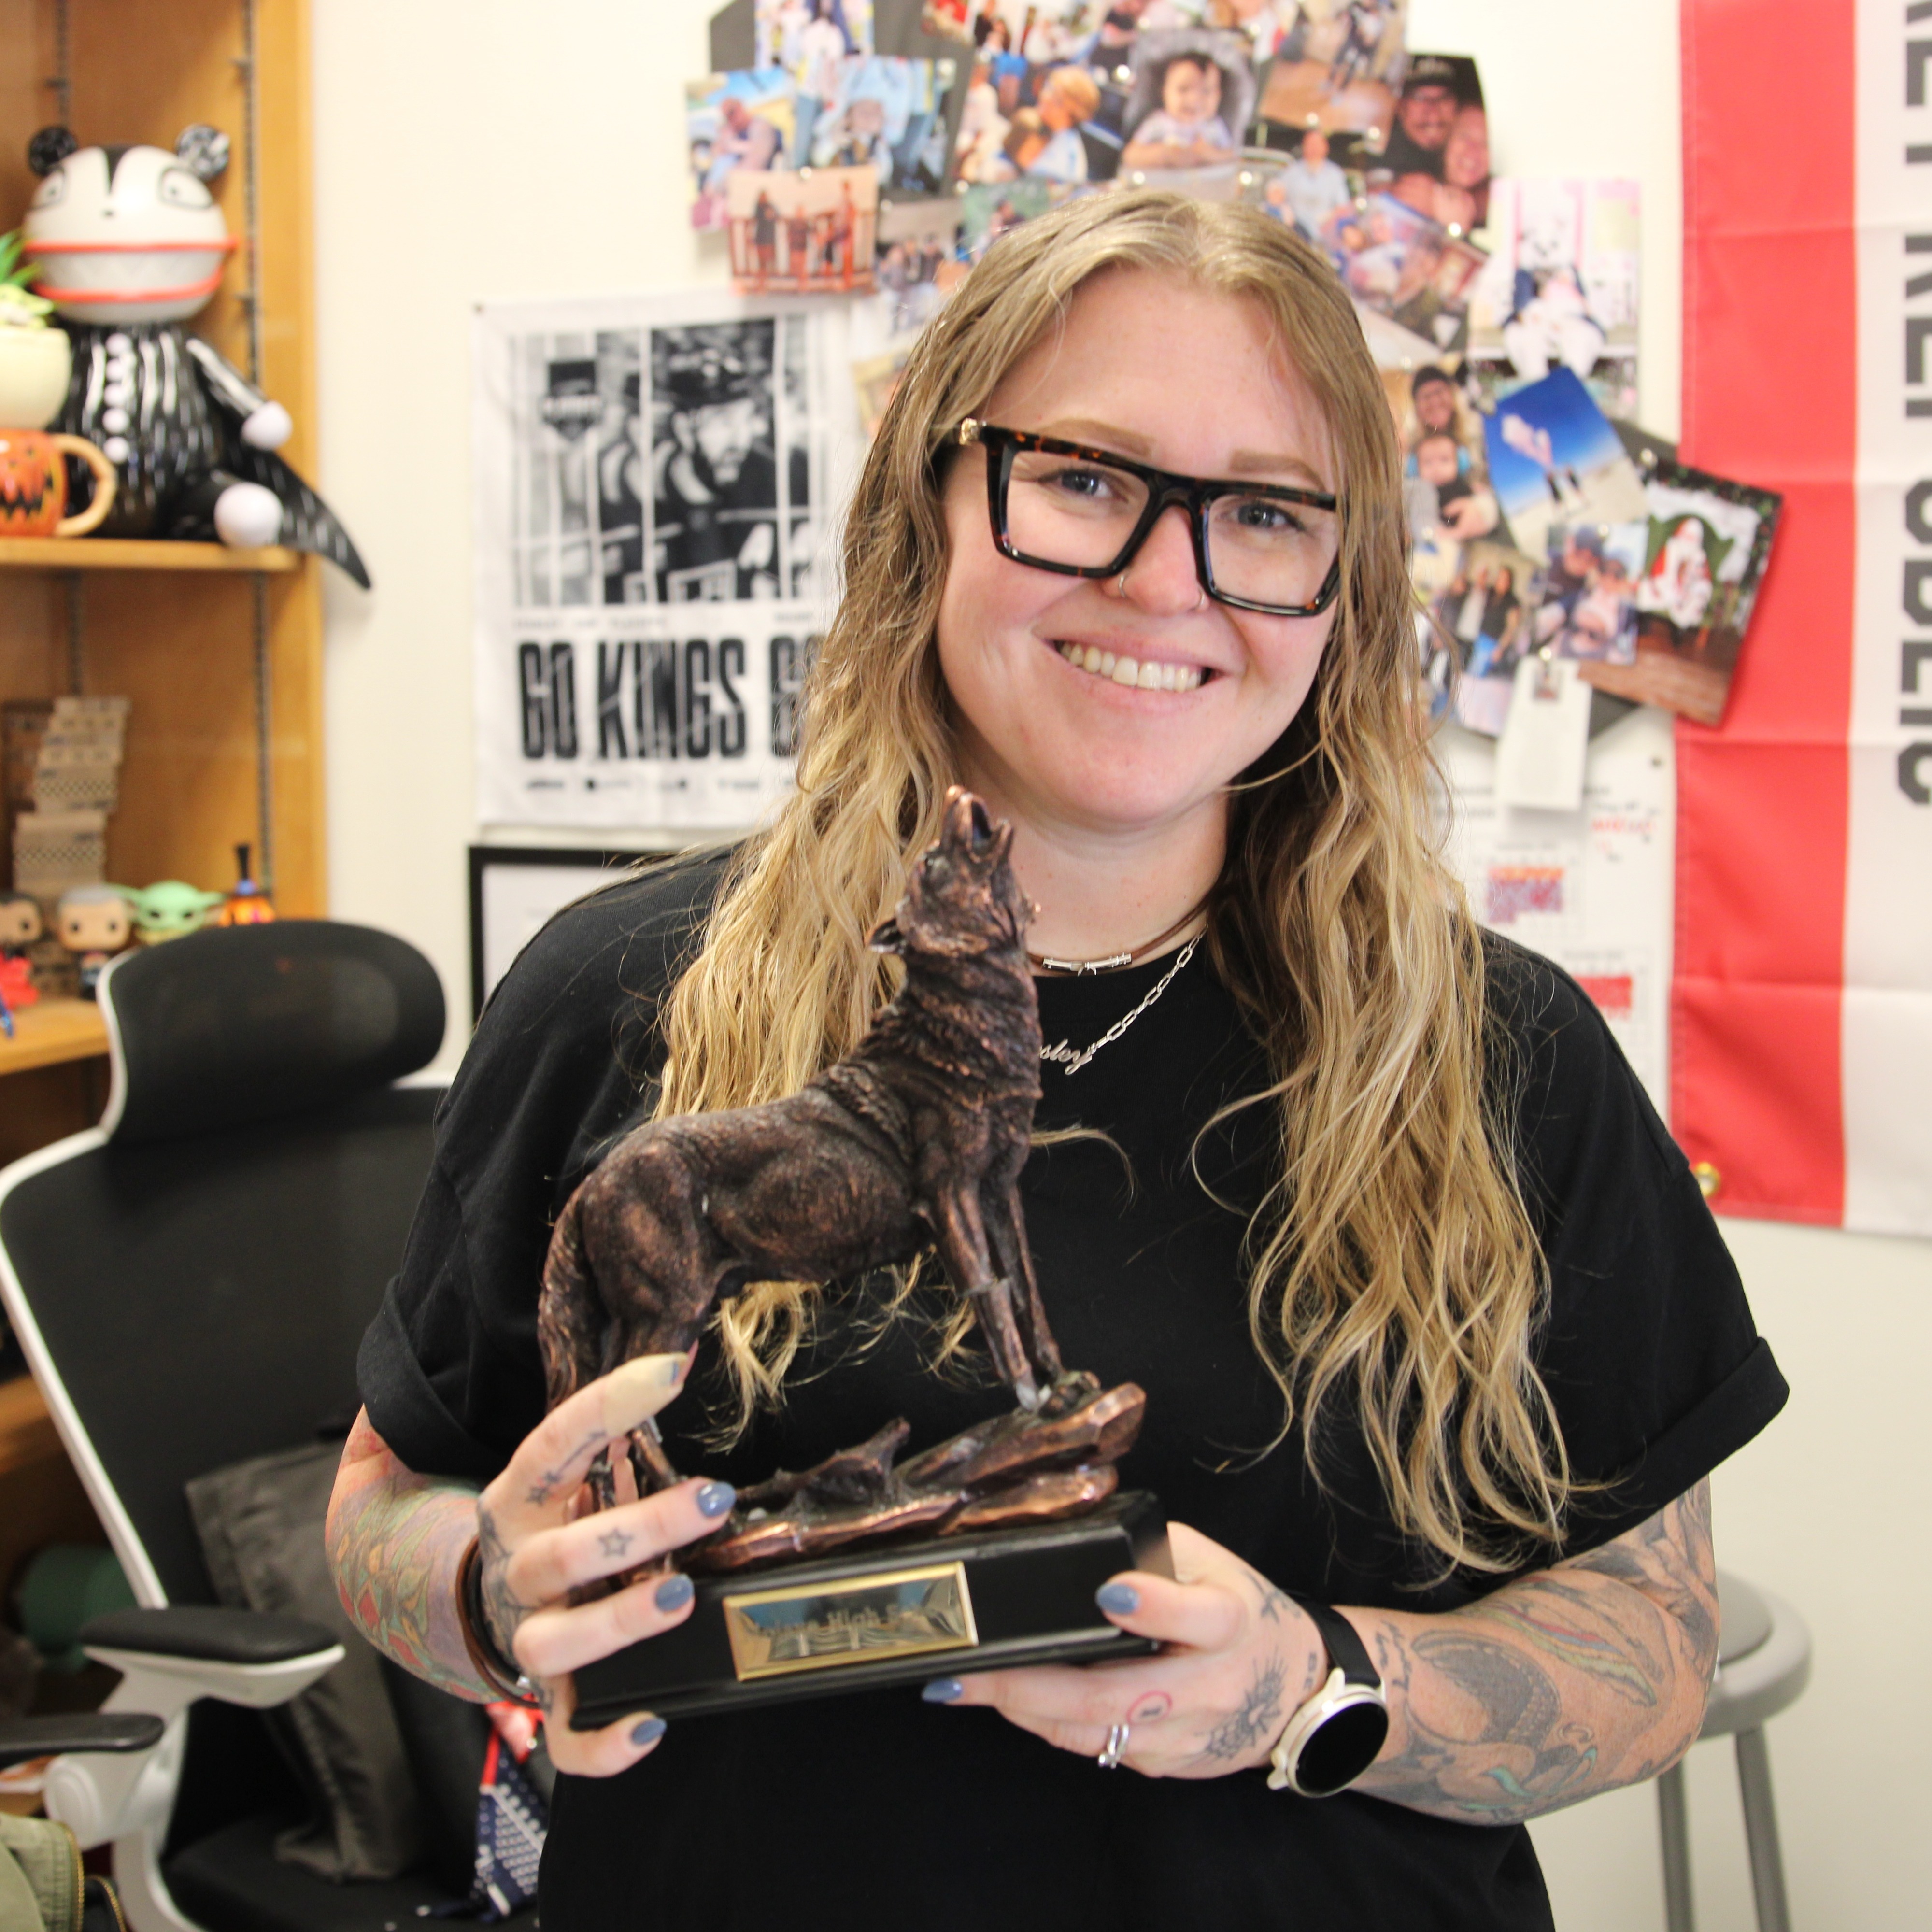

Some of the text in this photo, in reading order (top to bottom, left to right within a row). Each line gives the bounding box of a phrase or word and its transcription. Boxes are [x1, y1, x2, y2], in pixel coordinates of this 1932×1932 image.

[519, 641, 577, 758] GO
[598, 639, 745, 758] KINGS
[1040, 1038, 1092, 1075] sley
